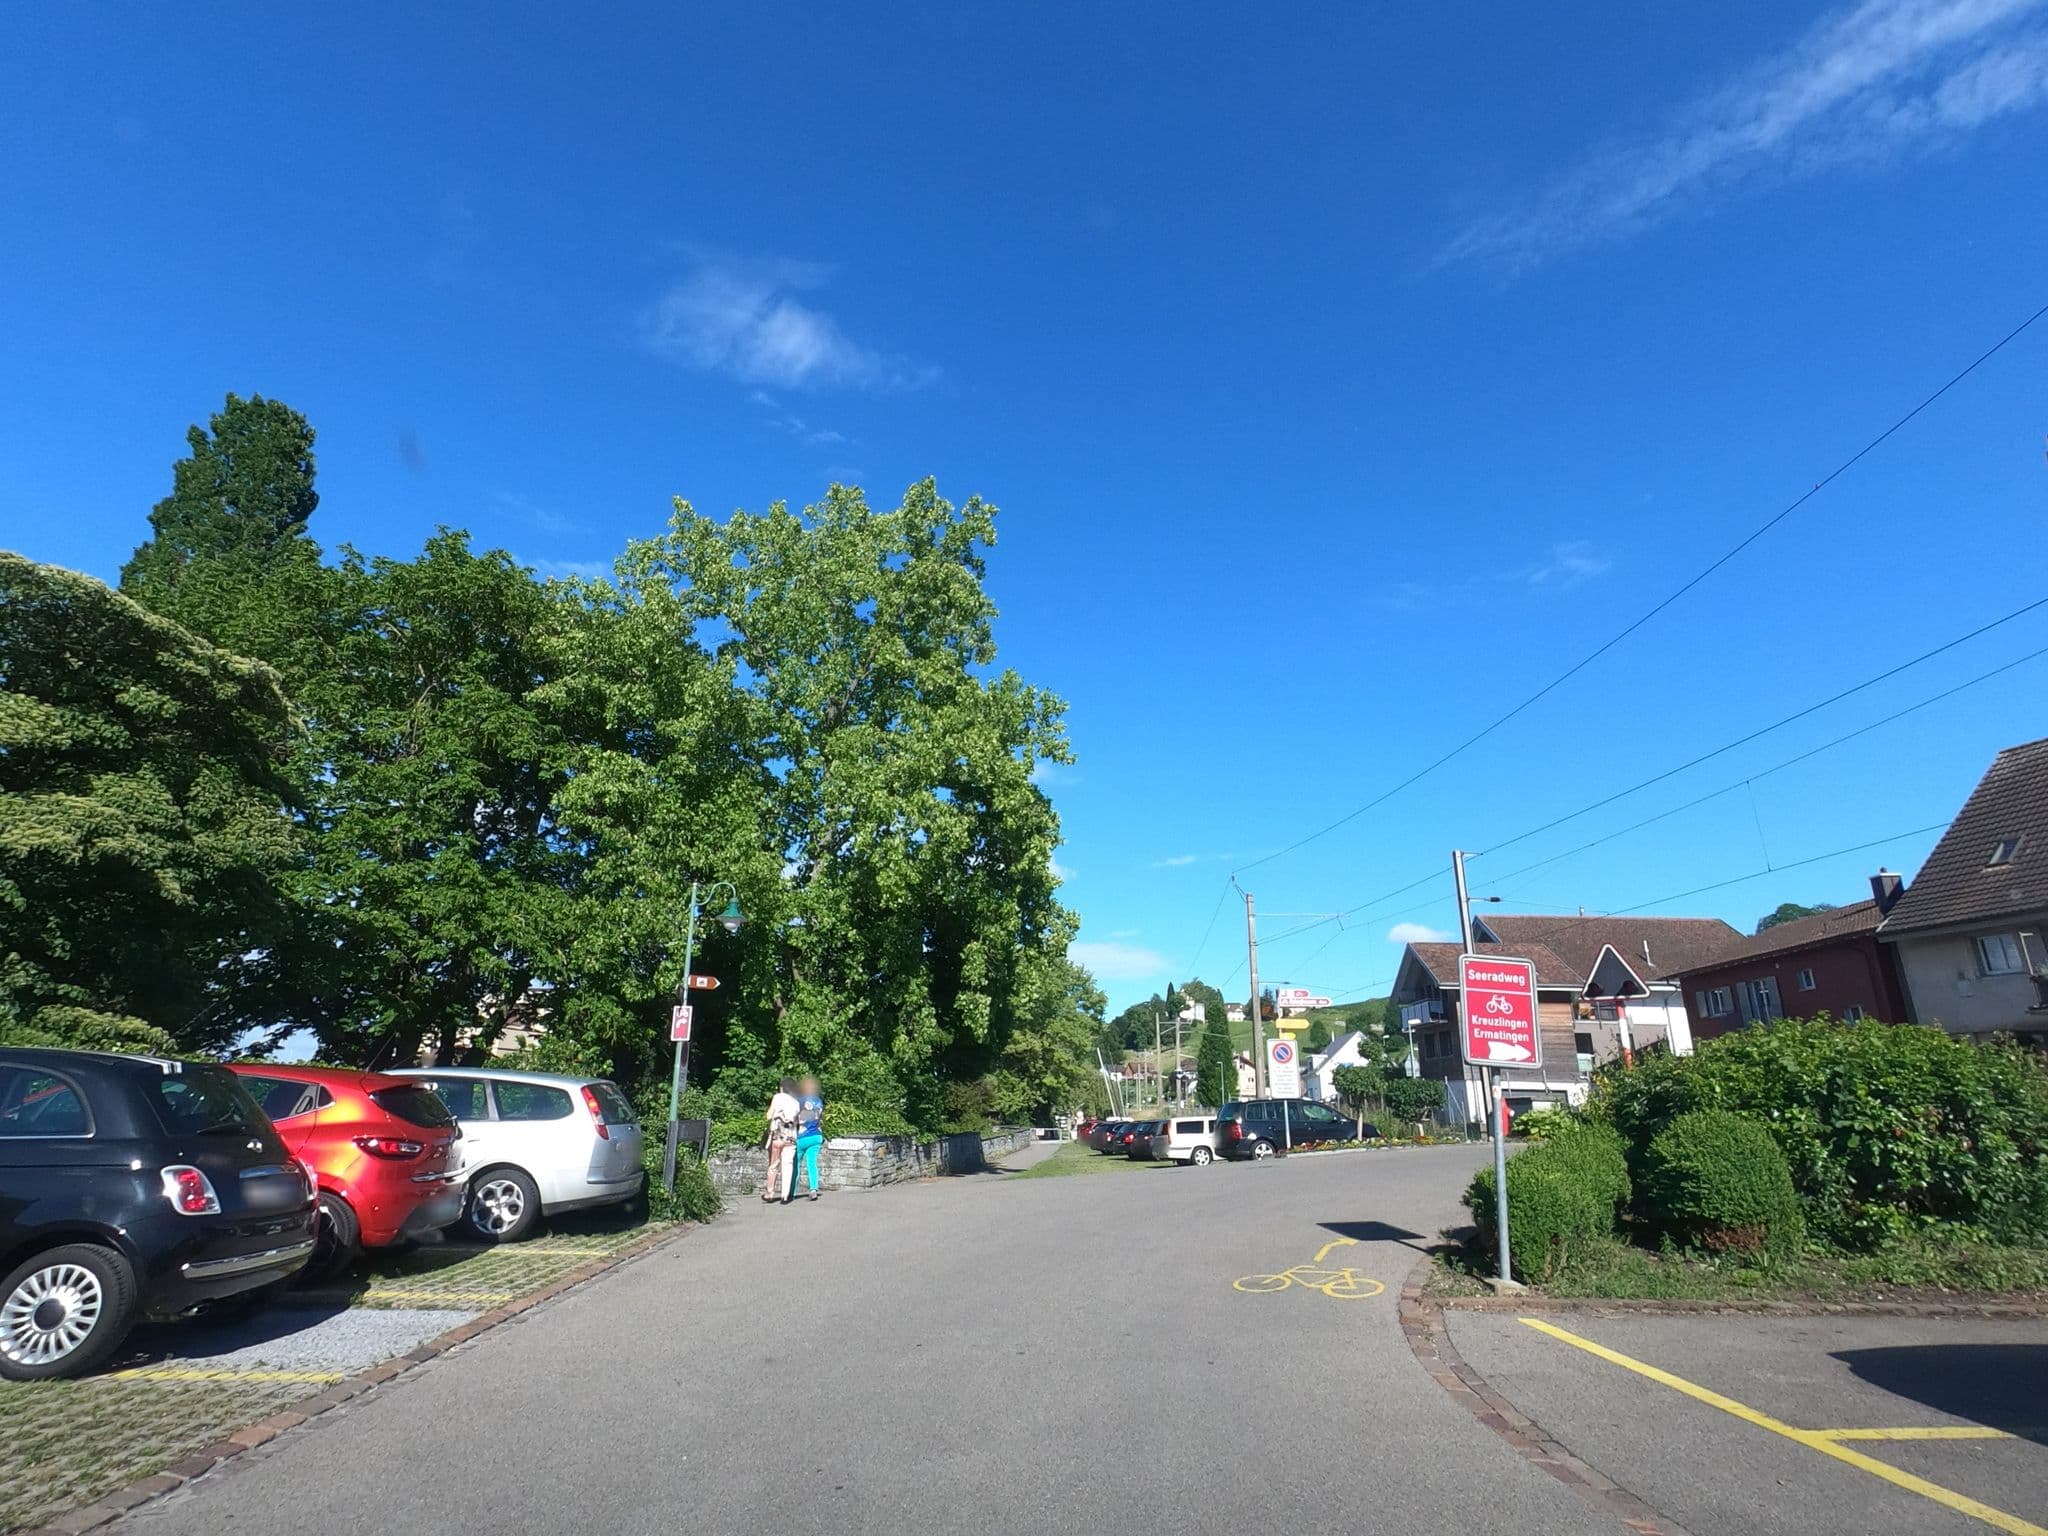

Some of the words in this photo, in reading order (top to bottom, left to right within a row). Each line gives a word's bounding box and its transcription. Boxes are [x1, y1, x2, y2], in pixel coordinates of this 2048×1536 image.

[1467, 969, 1526, 986] Seeradweg
[1471, 1015, 1528, 1029] Kreuzlingen
[1473, 1028, 1529, 1043] Ermatingen
